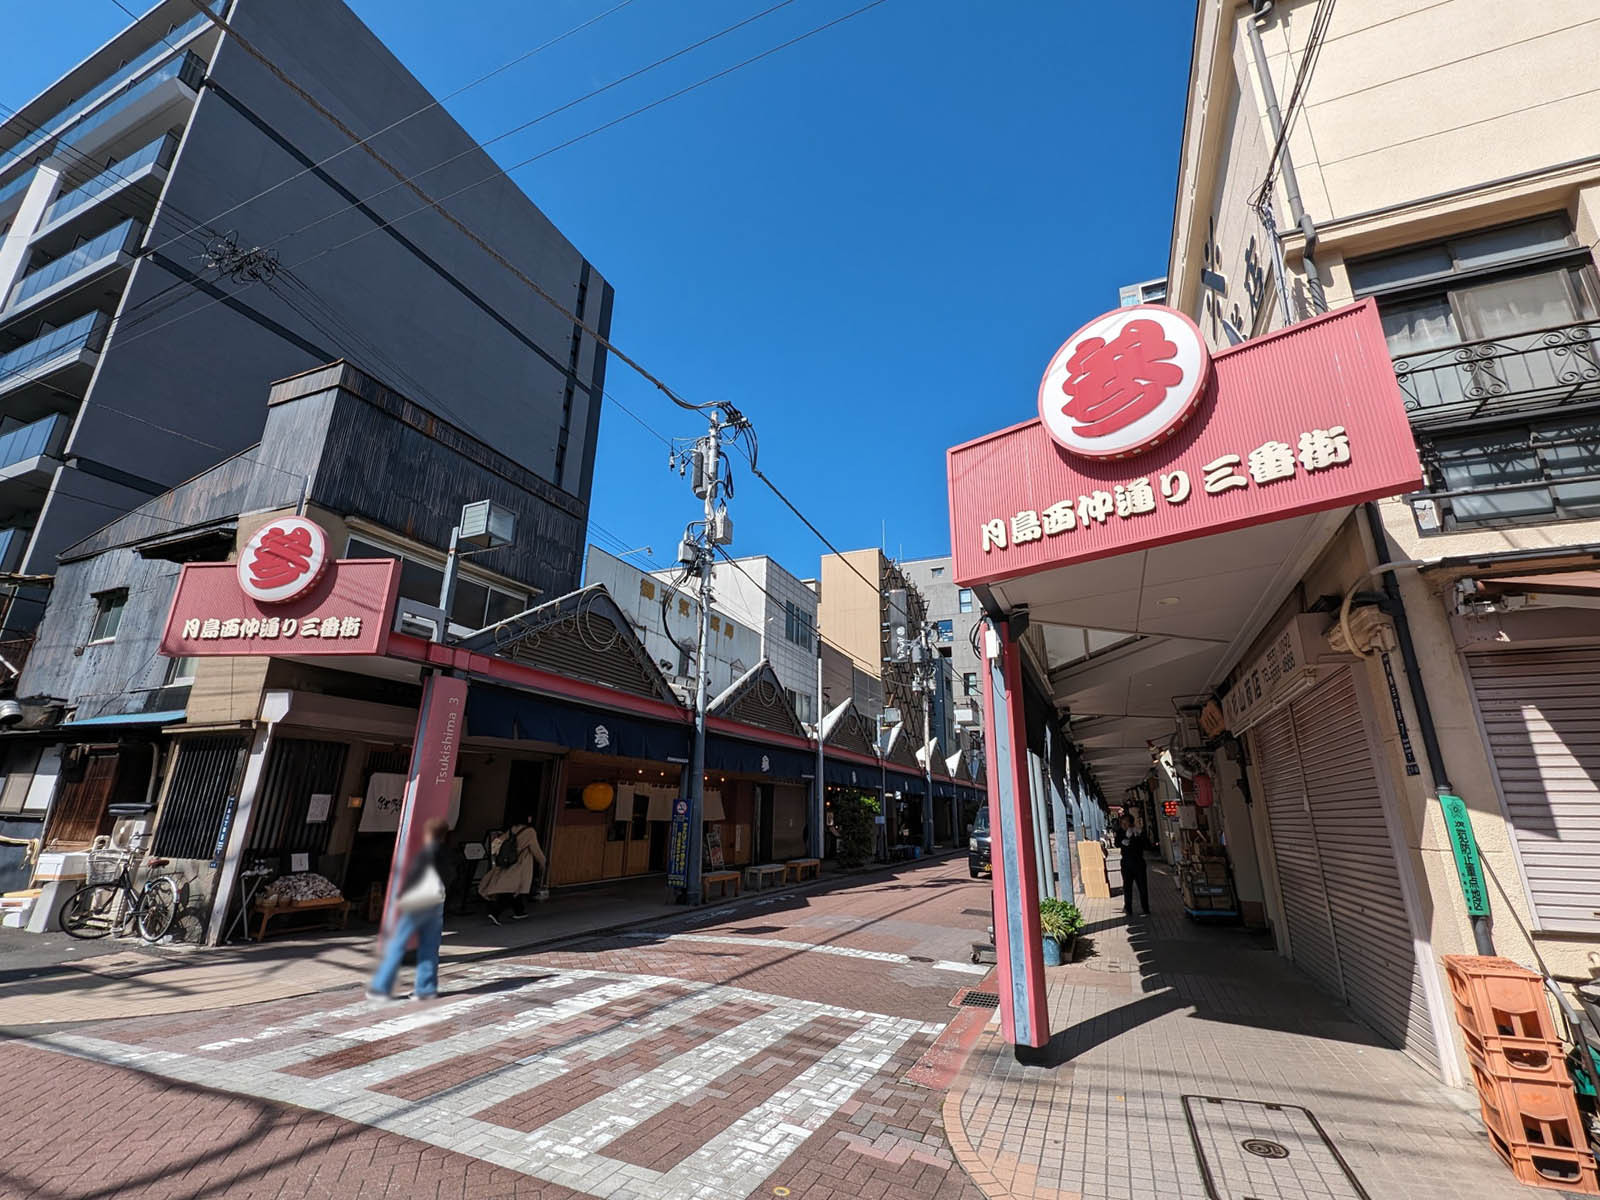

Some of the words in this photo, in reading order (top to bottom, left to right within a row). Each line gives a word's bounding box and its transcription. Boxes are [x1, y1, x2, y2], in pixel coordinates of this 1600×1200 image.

[981, 425, 1351, 553] 月島西仲通り三番街
[182, 617, 361, 640] 月島西仲通り三番街
[436, 712, 457, 785] Tsukishima
[448, 697, 460, 705] 3
